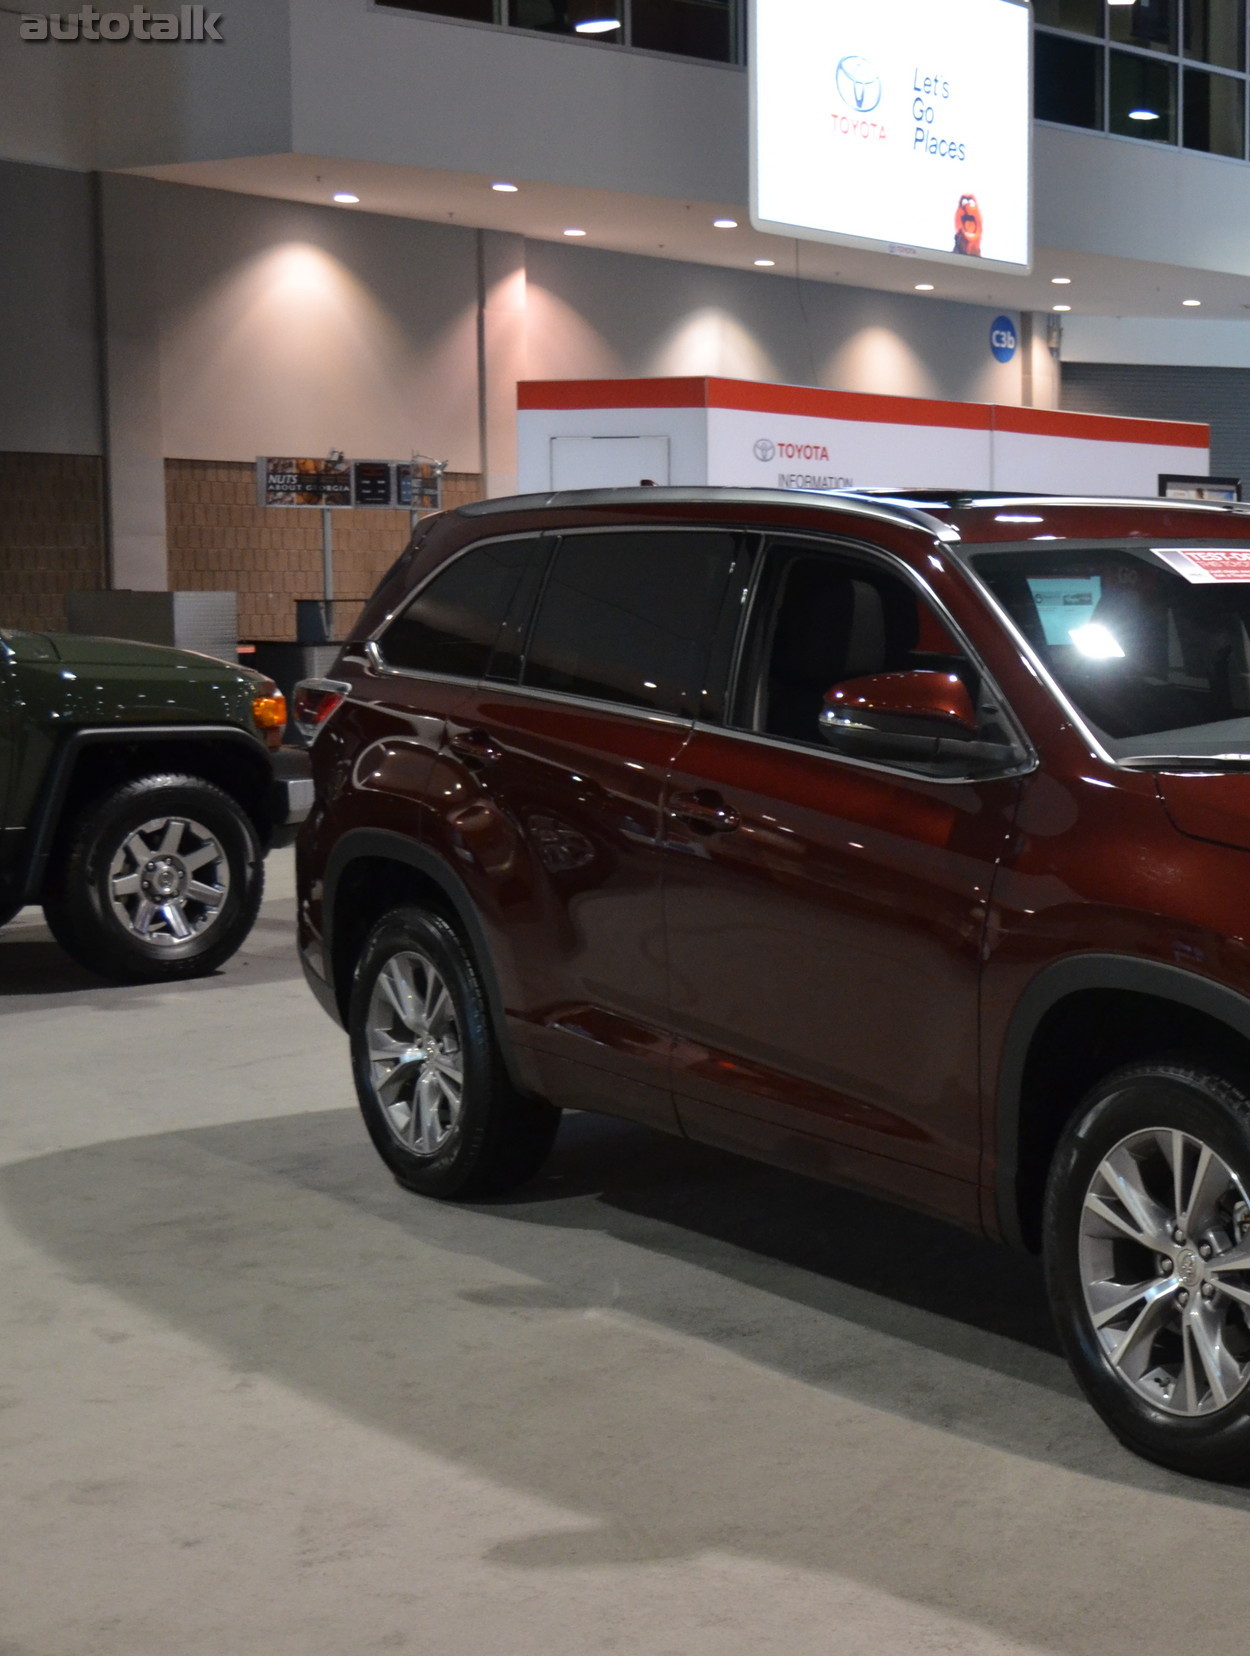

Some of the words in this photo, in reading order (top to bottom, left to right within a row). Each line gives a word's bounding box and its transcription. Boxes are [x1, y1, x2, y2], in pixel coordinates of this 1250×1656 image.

[913, 67, 950, 99] Let's
[912, 97, 934, 124] Go
[831, 113, 887, 140] TOYOTA
[913, 127, 966, 161] Places
[992, 330, 1015, 348] C3b
[777, 443, 830, 461] TOYOTA
[267, 484, 302, 492] ABOUT
[268, 474, 298, 484] NUTS
[778, 473, 854, 489] INFORMATION
